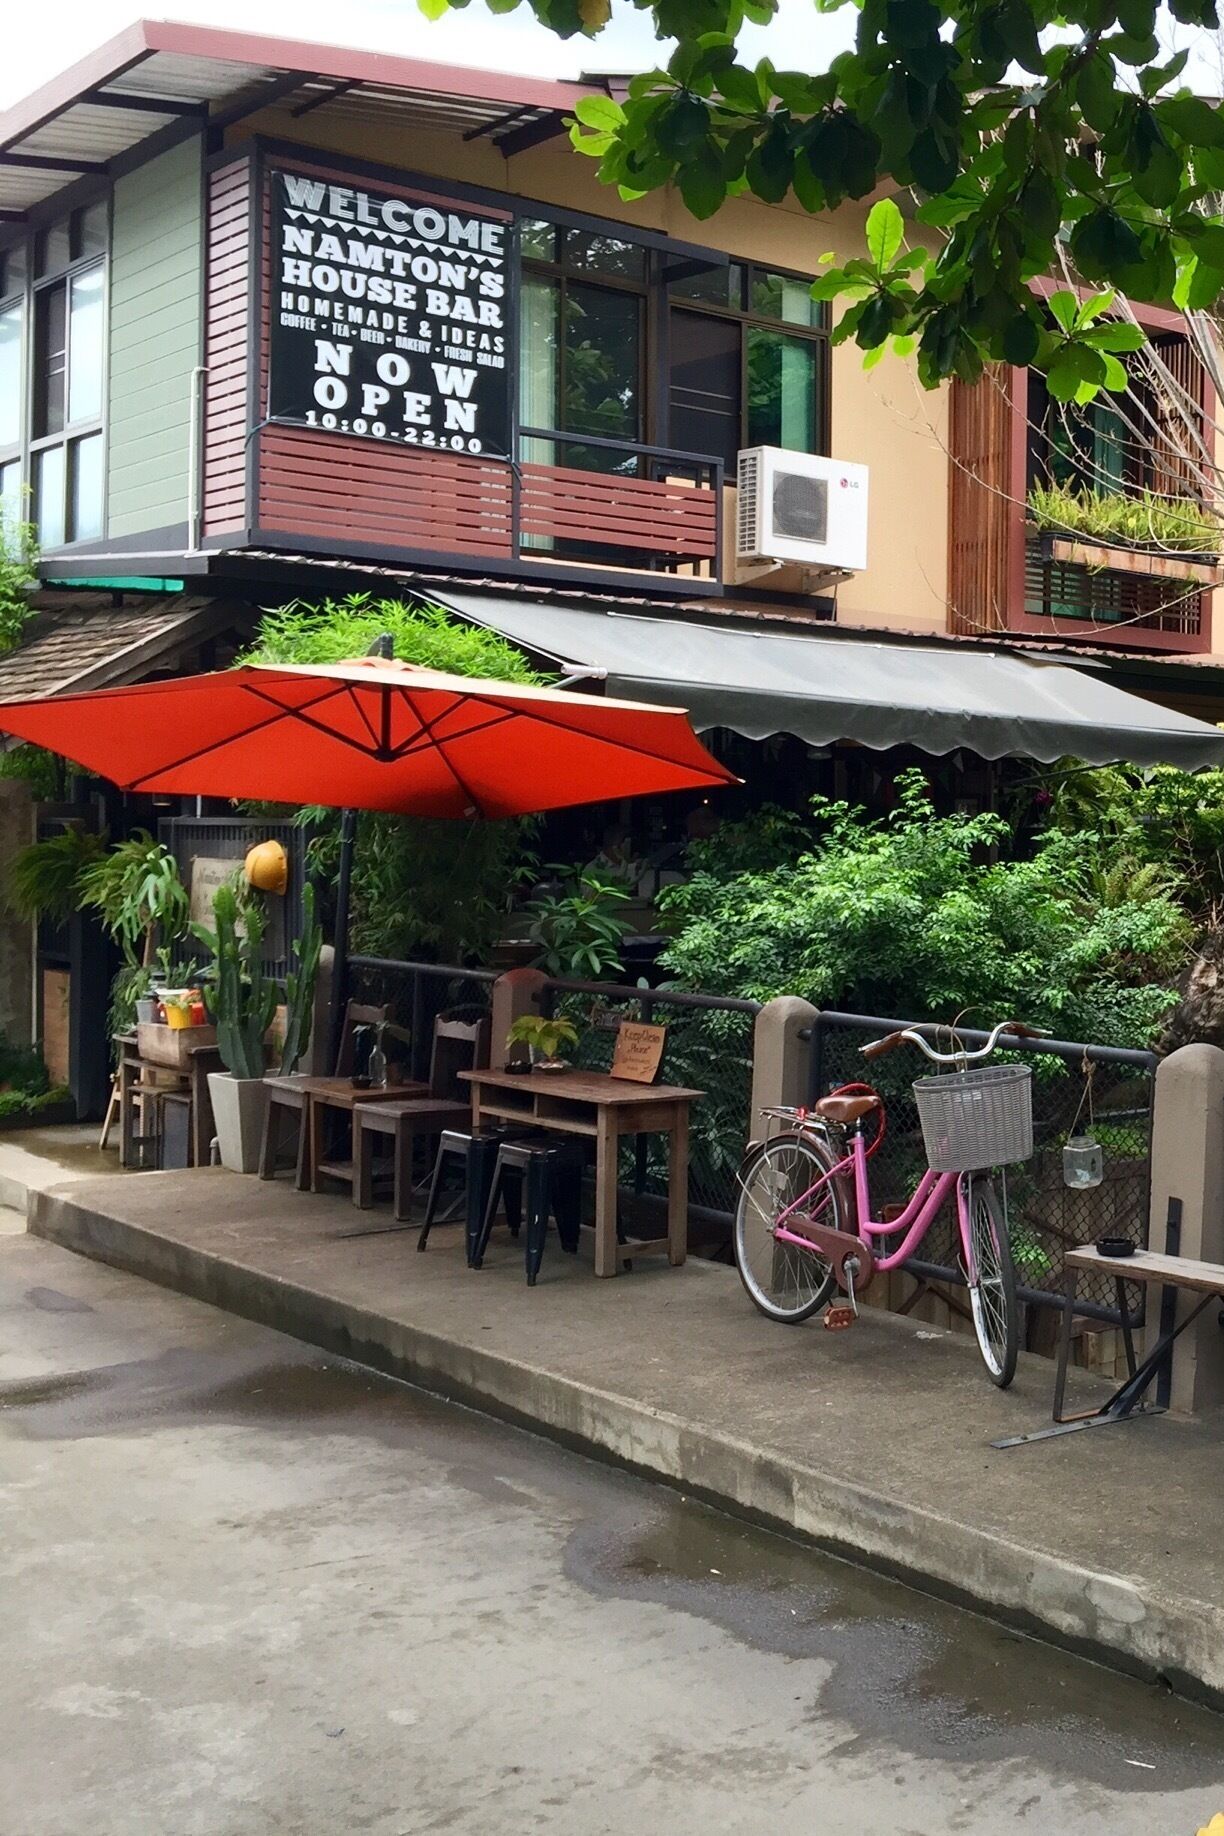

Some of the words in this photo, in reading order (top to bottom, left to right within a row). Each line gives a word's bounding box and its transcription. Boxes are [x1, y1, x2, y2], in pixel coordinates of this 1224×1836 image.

[283, 173, 504, 255] WELCOME
[281, 224, 504, 298] NAMTON'S
[281, 257, 417, 310] HOUSE
[426, 288, 503, 329] BAR
[281, 291, 408, 333] HOMEMADE
[419, 320, 432, 338] &
[442, 325, 504, 353] IDEAS
[280, 312, 317, 332] COFFEE
[331, 322, 350, 338] TEA
[360, 328, 385, 346] BEER
[395, 336, 431, 354] BAKERY
[444, 346, 473, 363] FRESH
[477, 351, 505, 369] SALAD
[314, 339, 479, 399] NOW
[305, 410, 482, 453] 10:00-22:00
[313, 376, 479, 433] OPEN
[849, 481, 859, 489] LG
